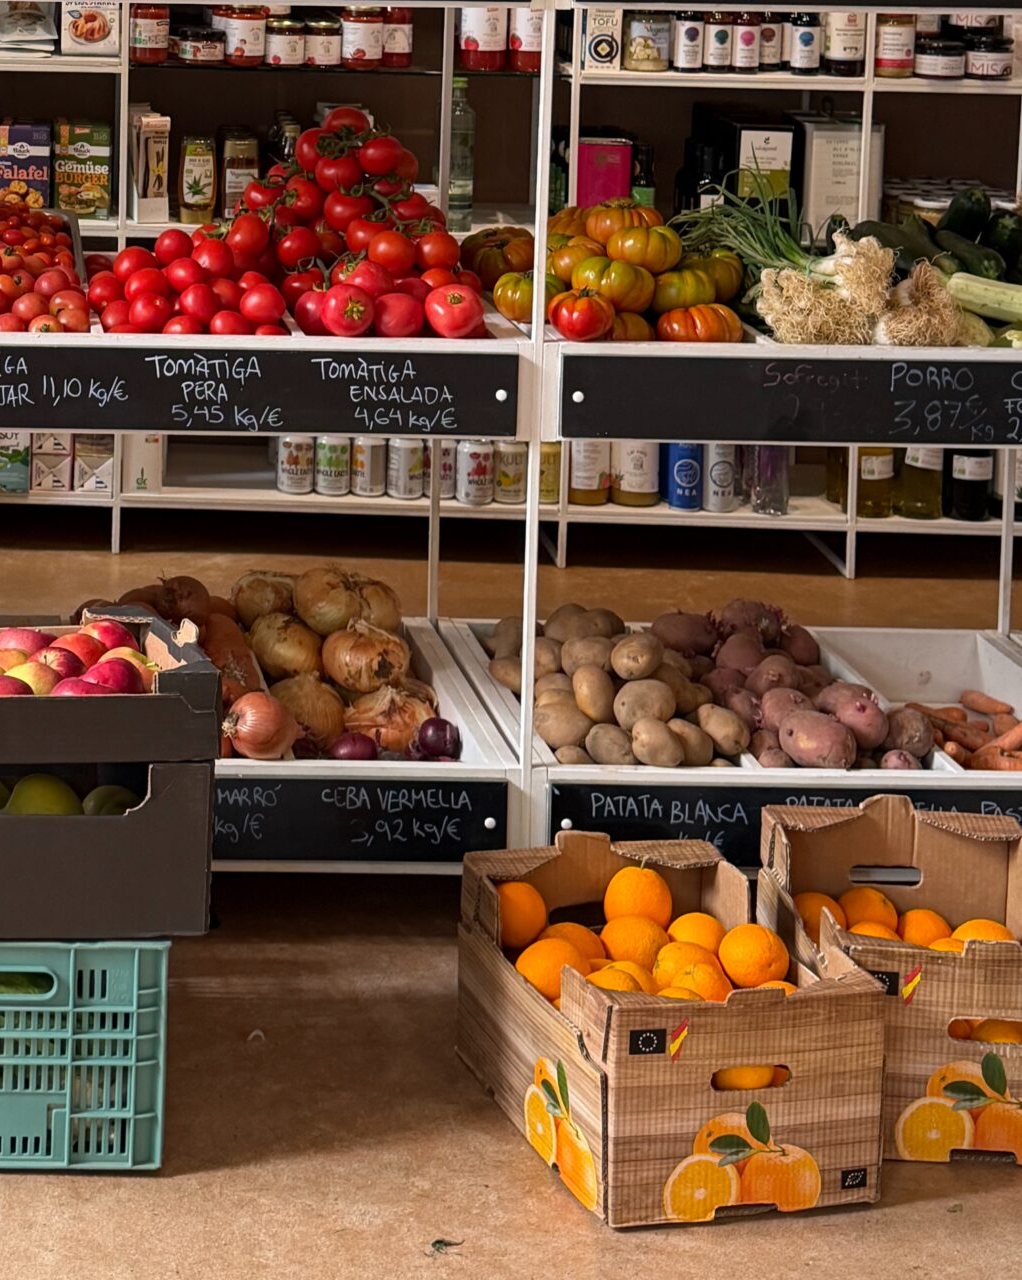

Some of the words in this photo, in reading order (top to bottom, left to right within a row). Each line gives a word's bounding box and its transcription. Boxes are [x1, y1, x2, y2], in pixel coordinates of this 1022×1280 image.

[593, 18, 618, 27] TOFU
[55, 160, 109, 174] Gemüse
[55, 172, 108, 184] BURGER
[890, 362, 974, 392] PORRO
[43, 375, 82, 407] 11,10
[181, 381, 228, 404] PERA
[349, 385, 454, 405] ENSALADA
[171, 404, 225, 427] 5,45
[354, 407, 403, 430] 4,64
[888, 400, 962, 435] 3,87
[0, 431, 19, 440] SOY
[322, 787, 371, 809] CEBA
[378, 788, 472, 813] VERMELLA
[591, 793, 663, 819] PATATA
[670, 799, 748, 826] BLANCA
